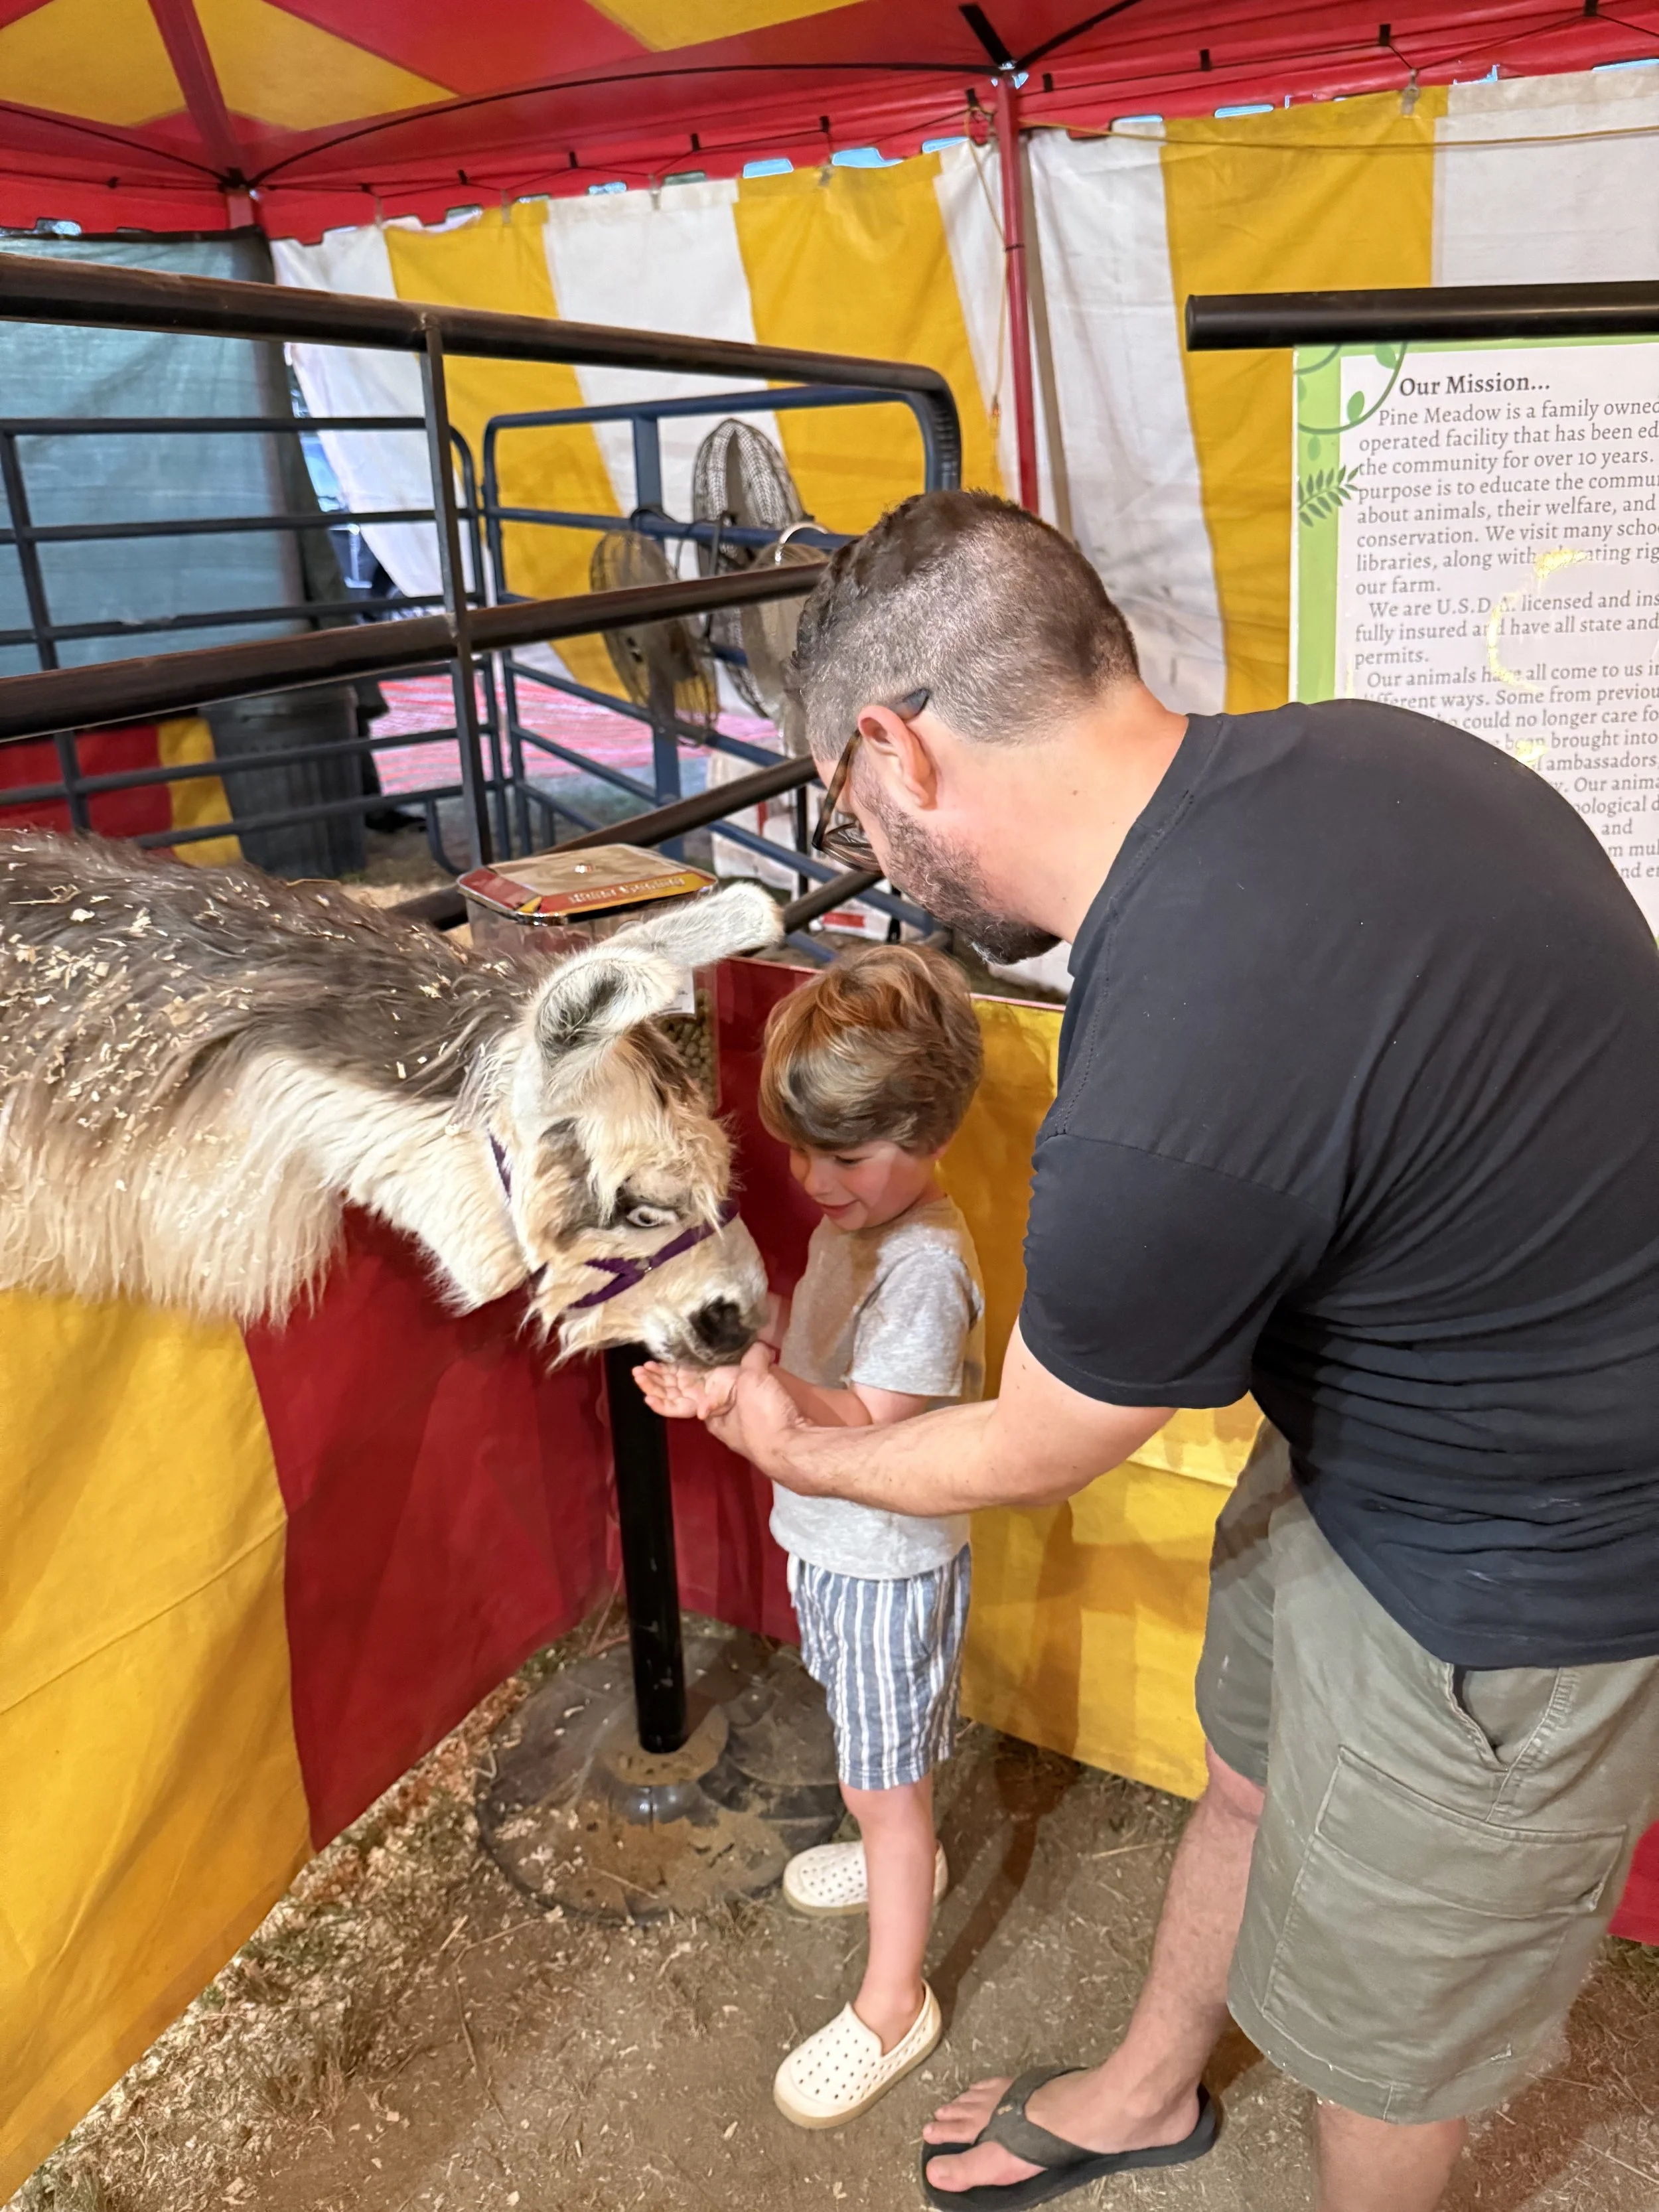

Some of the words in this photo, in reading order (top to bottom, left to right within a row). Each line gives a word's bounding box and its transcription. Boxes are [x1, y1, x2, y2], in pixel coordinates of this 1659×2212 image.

[1400, 378, 1440, 396] Our
[1445, 372, 1550, 394] Mission...
[1378, 409, 1418, 426] Pine
[1424, 404, 1500, 424] Meadow
[1506, 403, 1520, 420] is
[1526, 406, 1536, 419] a
[1542, 398, 1599, 421] family
[1359, 430, 1440, 456] operated
[1445, 427, 1508, 450] facility
[1514, 425, 1550, 444] that
[1555, 424, 1585, 442] has
[1591, 423, 1632, 441] been
[1359, 458, 1387, 476] the
[1392, 453, 1498, 475] community
[1503, 450, 1529, 469] for
[1534, 453, 1573, 467] over
[1578, 452, 1597, 466] 10
[1601, 450, 1654, 470] years.
[1359, 484, 1432, 504] purpose
[1436, 479, 1451, 496] is
[1457, 481, 1475, 495] to
[1479, 475, 1550, 493] educate
[1555, 472, 1584, 490] the
[1589, 475, 1659, 490] commu
[1357, 506, 1409, 524] about
[1413, 500, 1492, 520] animals,
[1497, 499, 1541, 518] their
[1546, 496, 1617, 516] welfare,
[1623, 493, 1656, 512] and
[1356, 526, 1479, 548] conservation.
[1485, 525, 1515, 542] We
[1520, 522, 1558, 540] visit
[1563, 524, 1613, 542] many
[1617, 518, 1659, 536] scho
[1356, 552, 1438, 572] libraries,
[1442, 550, 1493, 571] along
[1498, 546, 1536, 565] with
[1355, 582, 1387, 595] our
[1391, 575, 1441, 593] farm.
[1368, 601, 1399, 618] We
[1403, 603, 1431, 617] are
[1522, 591, 1593, 611] licensed
[1597, 589, 1631, 608] and
[1355, 623, 1394, 646] fully
[1399, 619, 1467, 640] insured
[1510, 617, 1550, 635] have
[1554, 615, 1575, 633] all
[1579, 618, 1622, 632] state
[1354, 646, 1429, 670] permits.
[1367, 672, 1402, 688] Our
[1406, 666, 1477, 686] animals
[1481, 666, 1521, 683] he
[1526, 663, 1546, 681] all
[1551, 666, 1597, 680] come
[1602, 664, 1619, 678] to
[1624, 664, 1644, 677] us
[1364, 692, 1439, 709] fferent
[1441, 694, 1490, 711] ways.
[1495, 690, 1544, 705] Some
[1550, 685, 1591, 703] from
[1462, 709, 1510, 729] could
[1515, 714, 1538, 727] no
[1542, 708, 1598, 730] longer
[1601, 710, 1638, 723] care
[1551, 729, 1619, 751] brought
[1624, 728, 1658, 746] into
[1573, 776, 1607, 792] Our
[1574, 794, 1646, 818] ological
[1601, 817, 1633, 836] and
